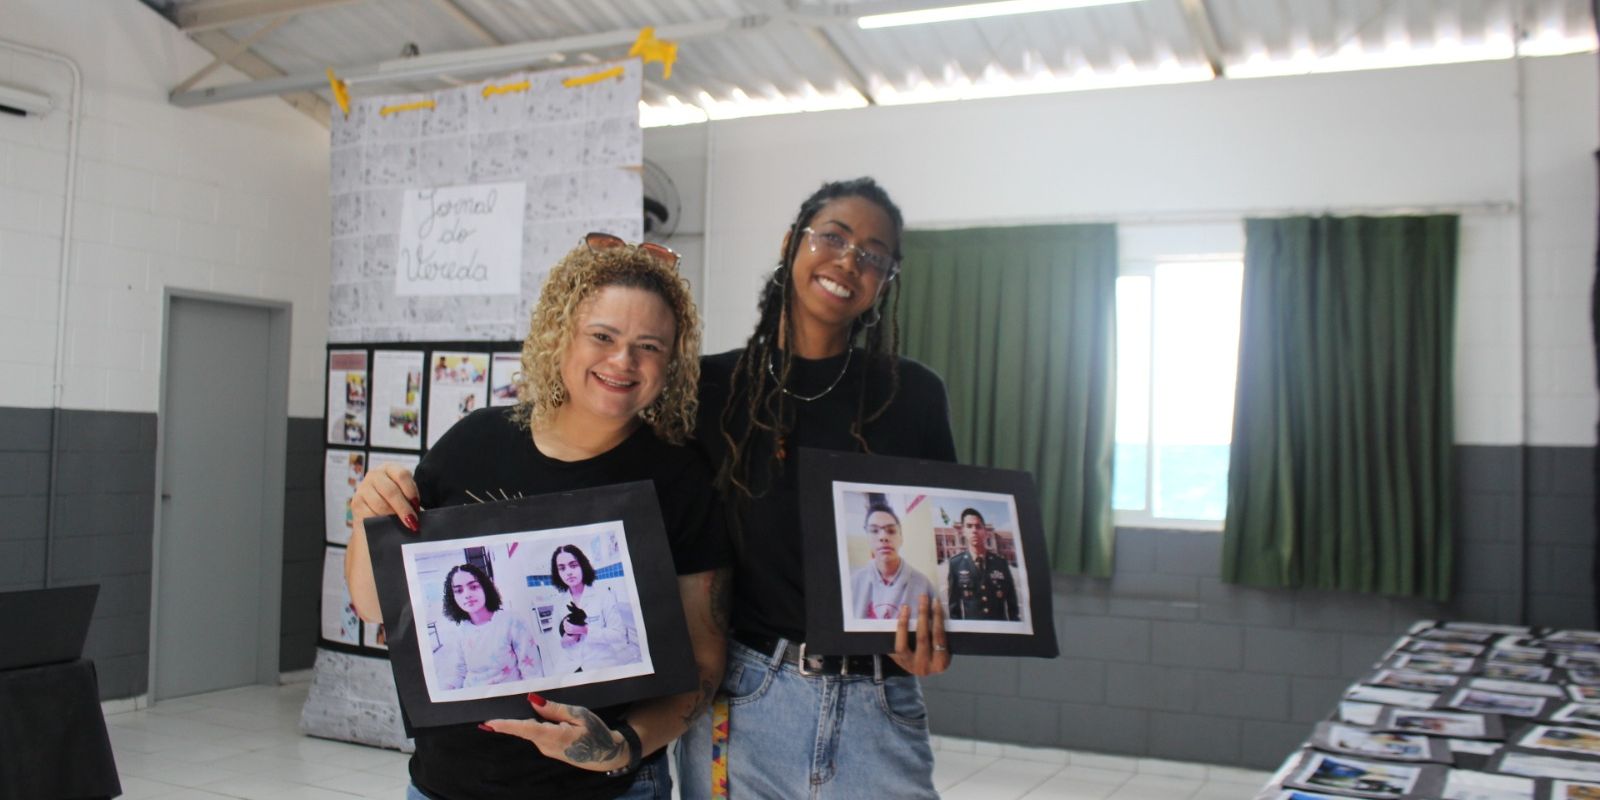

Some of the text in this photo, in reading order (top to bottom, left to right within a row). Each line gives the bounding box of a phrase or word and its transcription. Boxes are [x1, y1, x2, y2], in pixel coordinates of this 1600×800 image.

[418, 187, 497, 240] Jornal
[437, 218, 477, 244] do
[401, 243, 488, 282] Vereda
